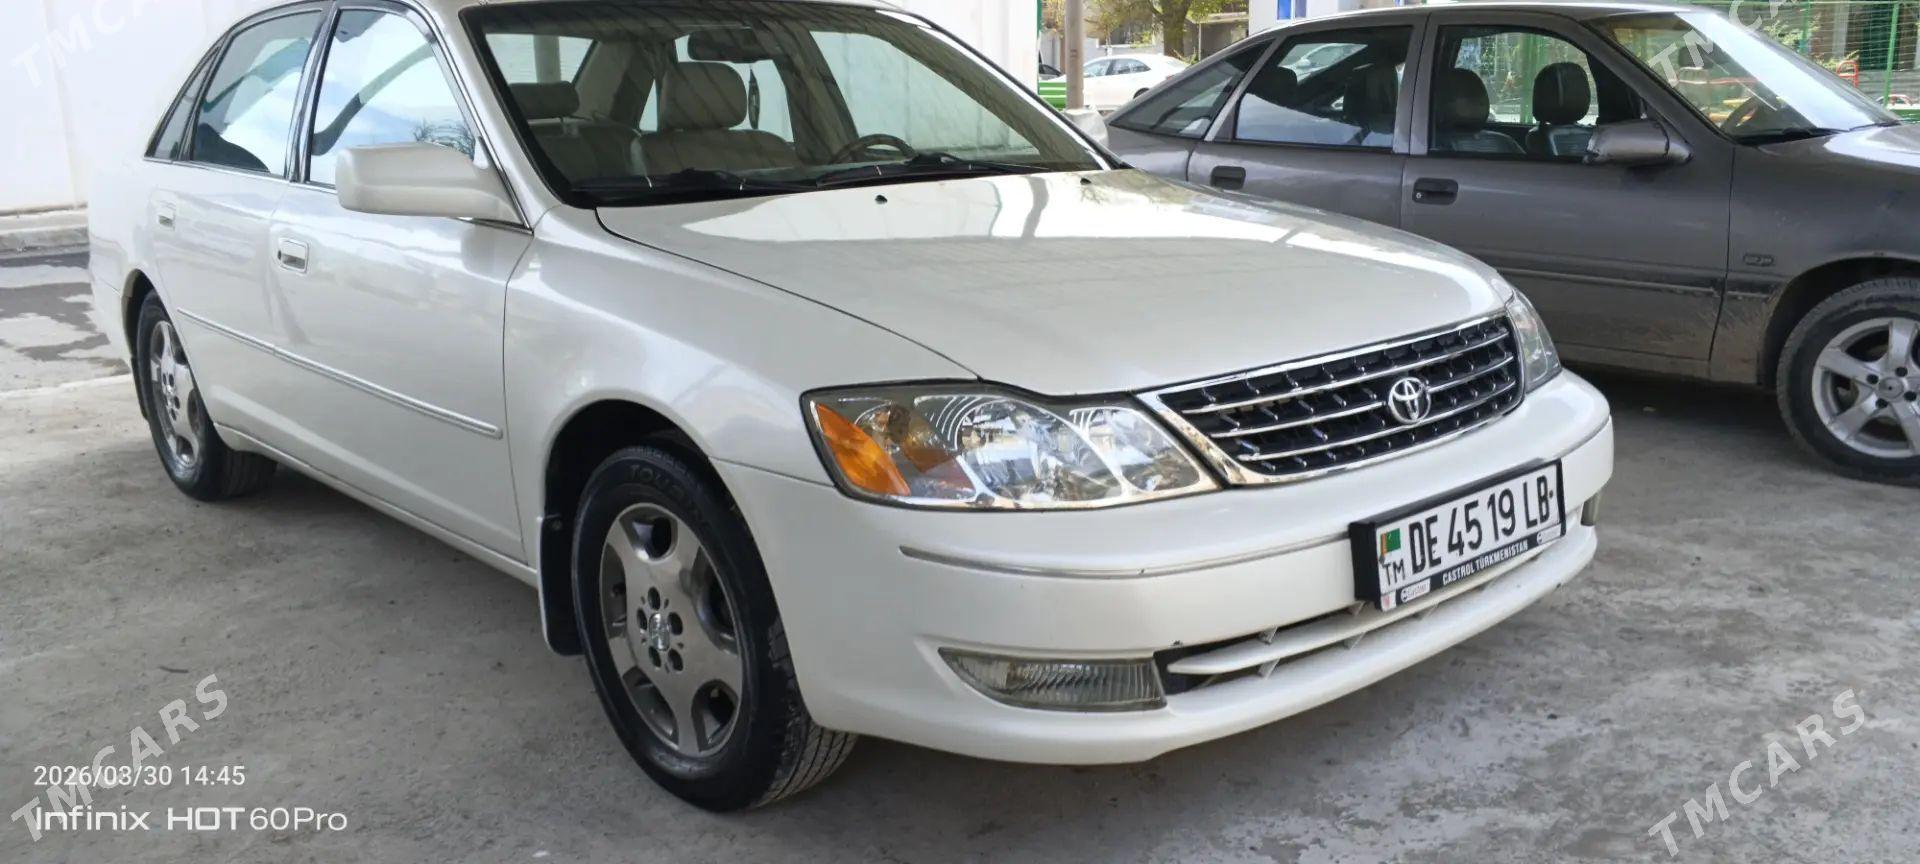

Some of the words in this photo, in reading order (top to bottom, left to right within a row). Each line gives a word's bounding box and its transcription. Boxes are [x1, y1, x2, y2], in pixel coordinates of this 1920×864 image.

[1409, 515, 1442, 575] DE
[1448, 500, 1483, 557] 45
[1487, 488, 1516, 542] 19
[1523, 475, 1551, 530] LB
[1382, 557, 1406, 586] TM
[1442, 560, 1475, 586] CASTROL
